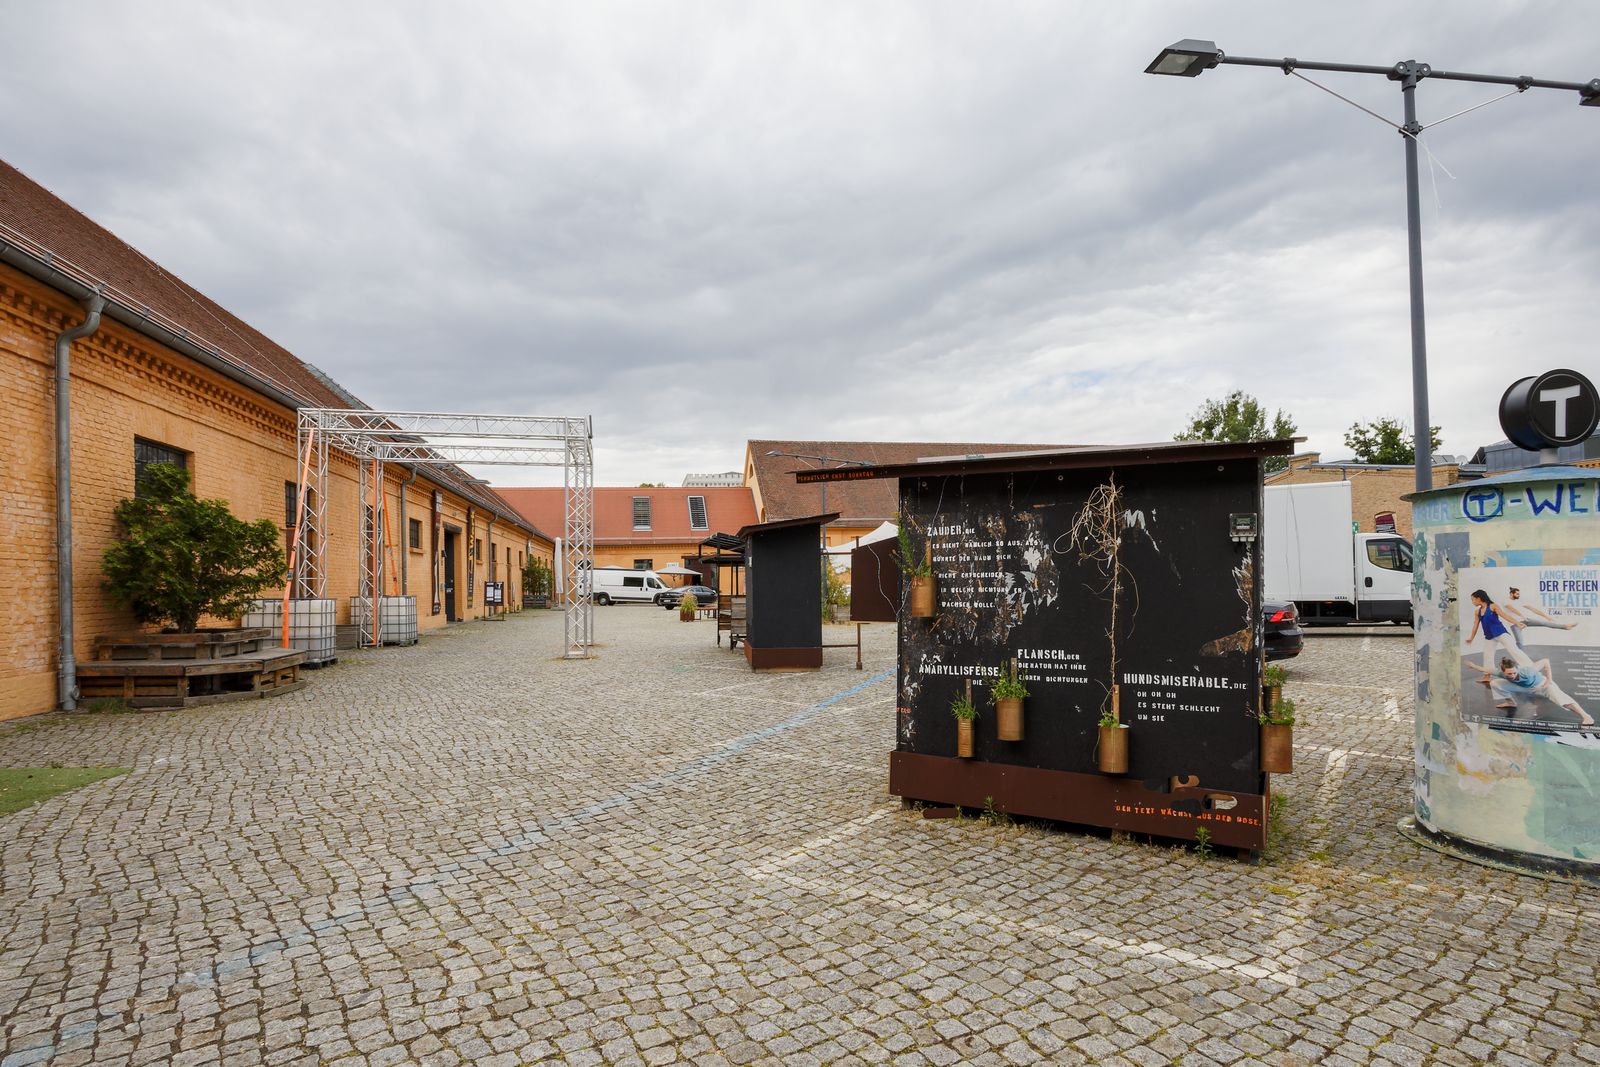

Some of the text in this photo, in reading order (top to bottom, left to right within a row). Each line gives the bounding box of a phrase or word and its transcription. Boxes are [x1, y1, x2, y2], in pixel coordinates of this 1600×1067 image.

[1540, 384, 1580, 437] T
[1462, 482, 1600, 523] T-WE
[1539, 569, 1597, 580] LANGE NACHT
[1539, 580, 1599, 592] DER FREIEN
[1540, 592, 1599, 607] THEATER
[1233, 682, 1247, 690] DIE
[1151, 702, 1176, 711] STEHT
[1179, 704, 1221, 713] SCHLECHT
